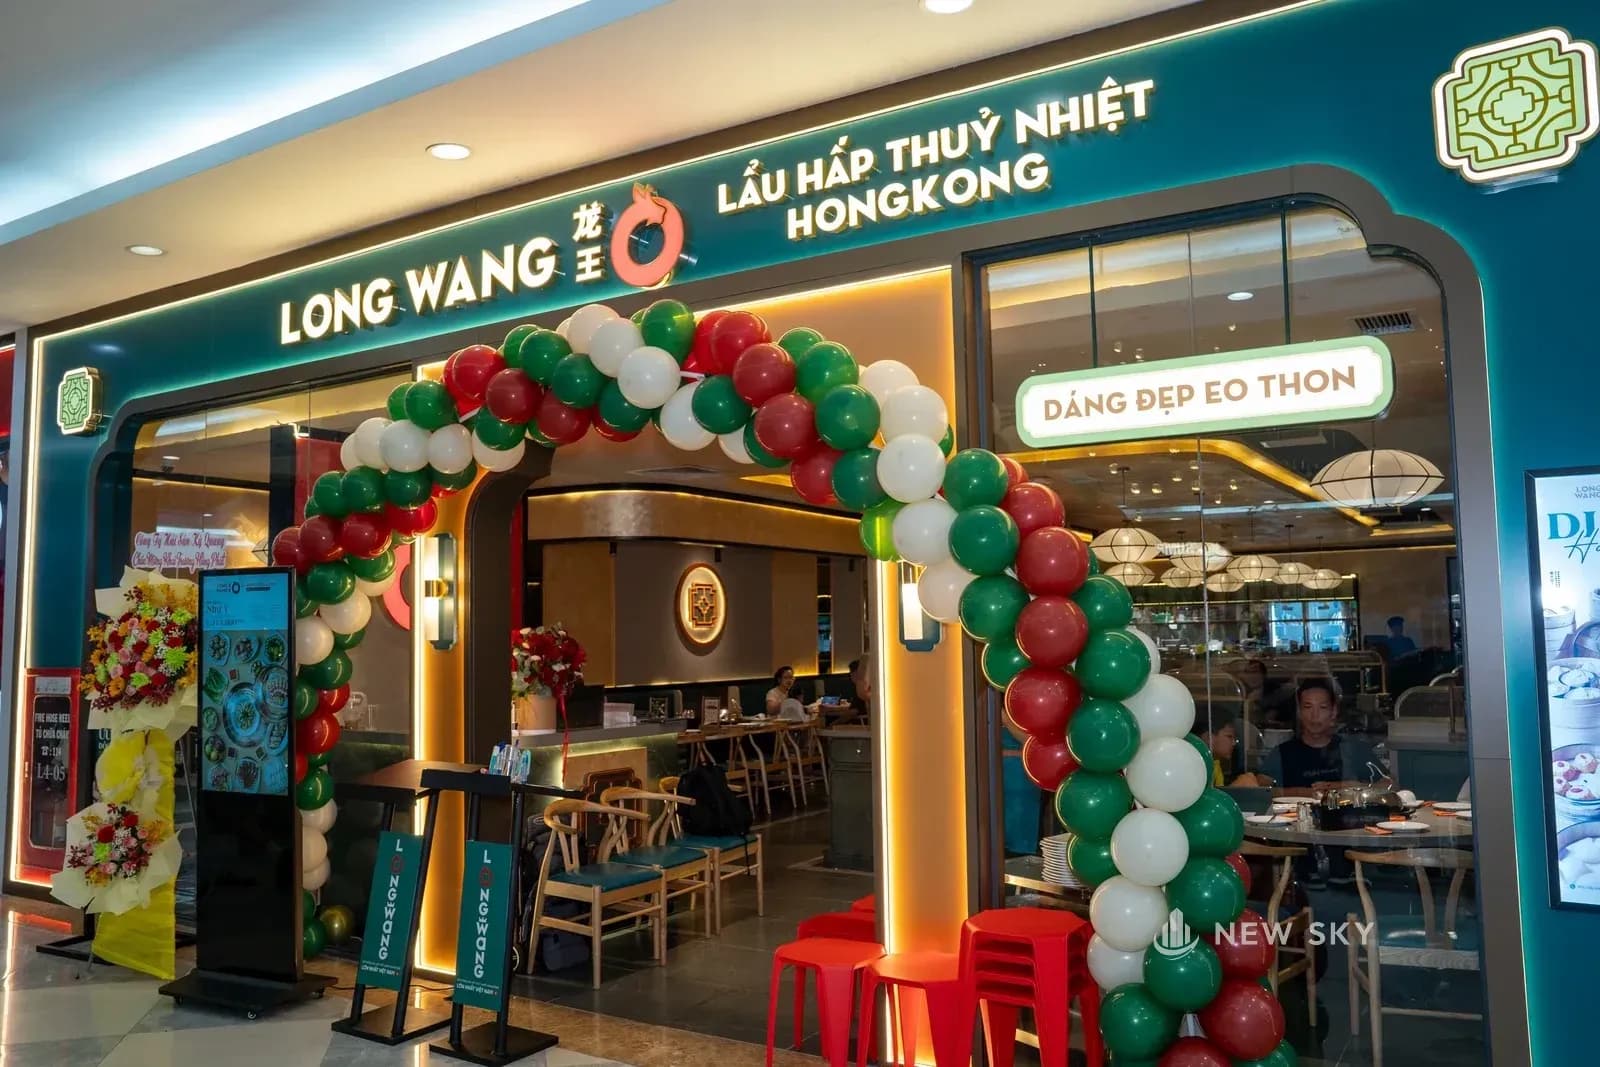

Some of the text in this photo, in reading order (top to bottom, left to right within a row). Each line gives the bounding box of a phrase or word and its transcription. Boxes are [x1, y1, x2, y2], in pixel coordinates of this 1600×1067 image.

[718, 76, 1155, 214] LẨU HẤP THUỶ NHIỆT
[786, 152, 1050, 240] HONGKONG
[280, 237, 558, 345] LONG WANG
[1043, 366, 1356, 421] DÁNG ĐẸP EO THON
[34, 713, 45, 723] FIRE
[46, 713, 58, 723] HOSE
[37, 763, 66, 781] L4-05
